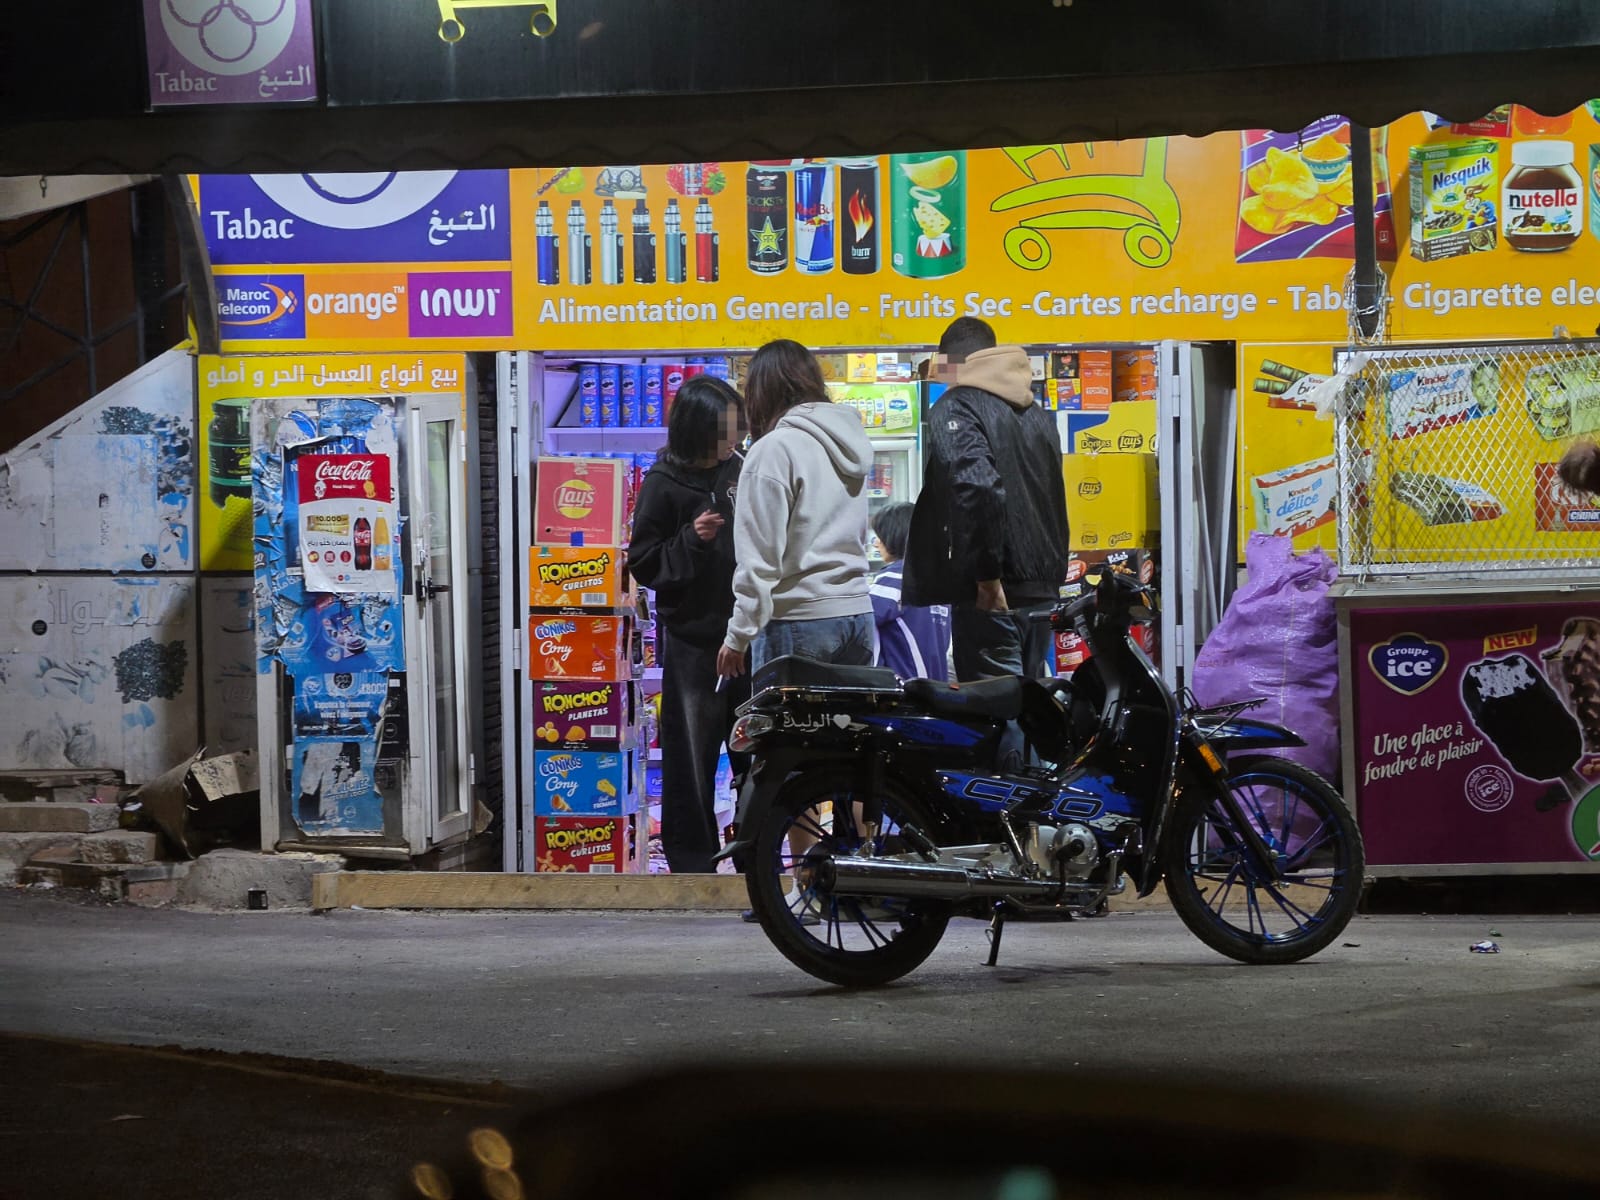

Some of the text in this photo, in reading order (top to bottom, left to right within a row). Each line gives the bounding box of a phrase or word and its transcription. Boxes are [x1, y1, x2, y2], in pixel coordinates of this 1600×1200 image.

[156, 72, 217, 93] Tabac
[258, 66, 311, 97] التبغ
[1433, 157, 1492, 190] Nesquik
[819, 202, 835, 215] Bu
[1509, 189, 1578, 208] nutella
[211, 209, 295, 240] Tabac
[428, 204, 496, 245] التبغ
[227, 288, 270, 301] Maroc
[307, 290, 398, 320] orange
[421, 287, 500, 318] inwi
[538, 296, 717, 324] Alimentation
[726, 293, 850, 322] Generale
[879, 293, 955, 318] Fruits
[964, 292, 1012, 317] Sec
[1130, 287, 1257, 320] recharge
[1403, 283, 1542, 315] Cigarette
[217, 302, 271, 316] Telecom
[207, 360, 458, 389] بيع أنواع العسل الحر و أملو
[1417, 373, 1449, 386] Kinder
[315, 460, 375, 481] Coca-Cola
[1288, 486, 1311, 497] Kinder
[1276, 494, 1319, 516] délice
[539, 554, 609, 585] RONCHOS
[562, 578, 604, 591] CURLITOS
[540, 640, 574, 661] Cony
[1488, 630, 1534, 650] NEW
[1387, 647, 1429, 657] Groupe
[1386, 658, 1433, 677] ice
[542, 686, 612, 714] RONCHOS
[568, 707, 609, 721] PLANETAS
[1373, 721, 1463, 756] Une glace à
[1364, 737, 1484, 786] fondre de plaisir
[545, 776, 579, 797] Cony
[545, 822, 616, 851] RONCHOS
[570, 843, 612, 858] CURLITOS
